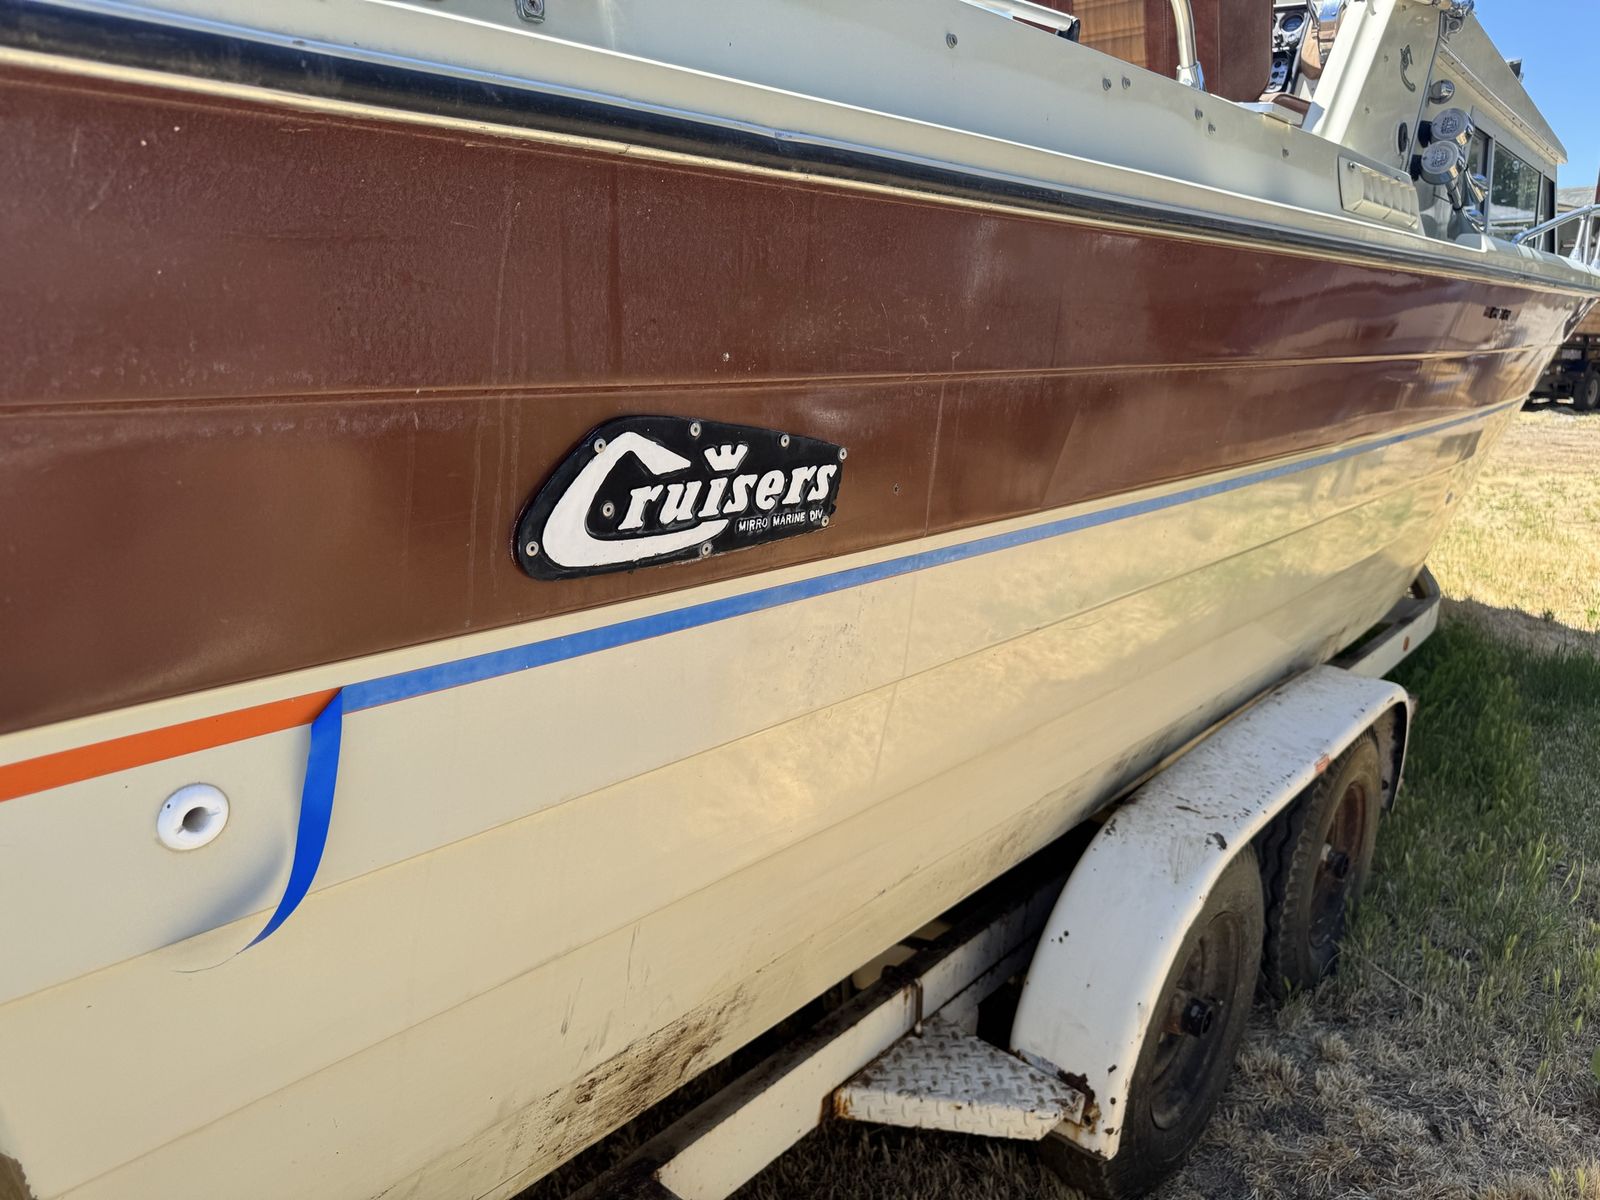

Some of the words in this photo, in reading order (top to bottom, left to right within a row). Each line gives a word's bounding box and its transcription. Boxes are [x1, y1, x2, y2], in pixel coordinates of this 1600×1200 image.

[542, 431, 838, 568] Cruisers
[738, 517, 768, 532] MIRRO
[772, 511, 806, 527] MARINE
